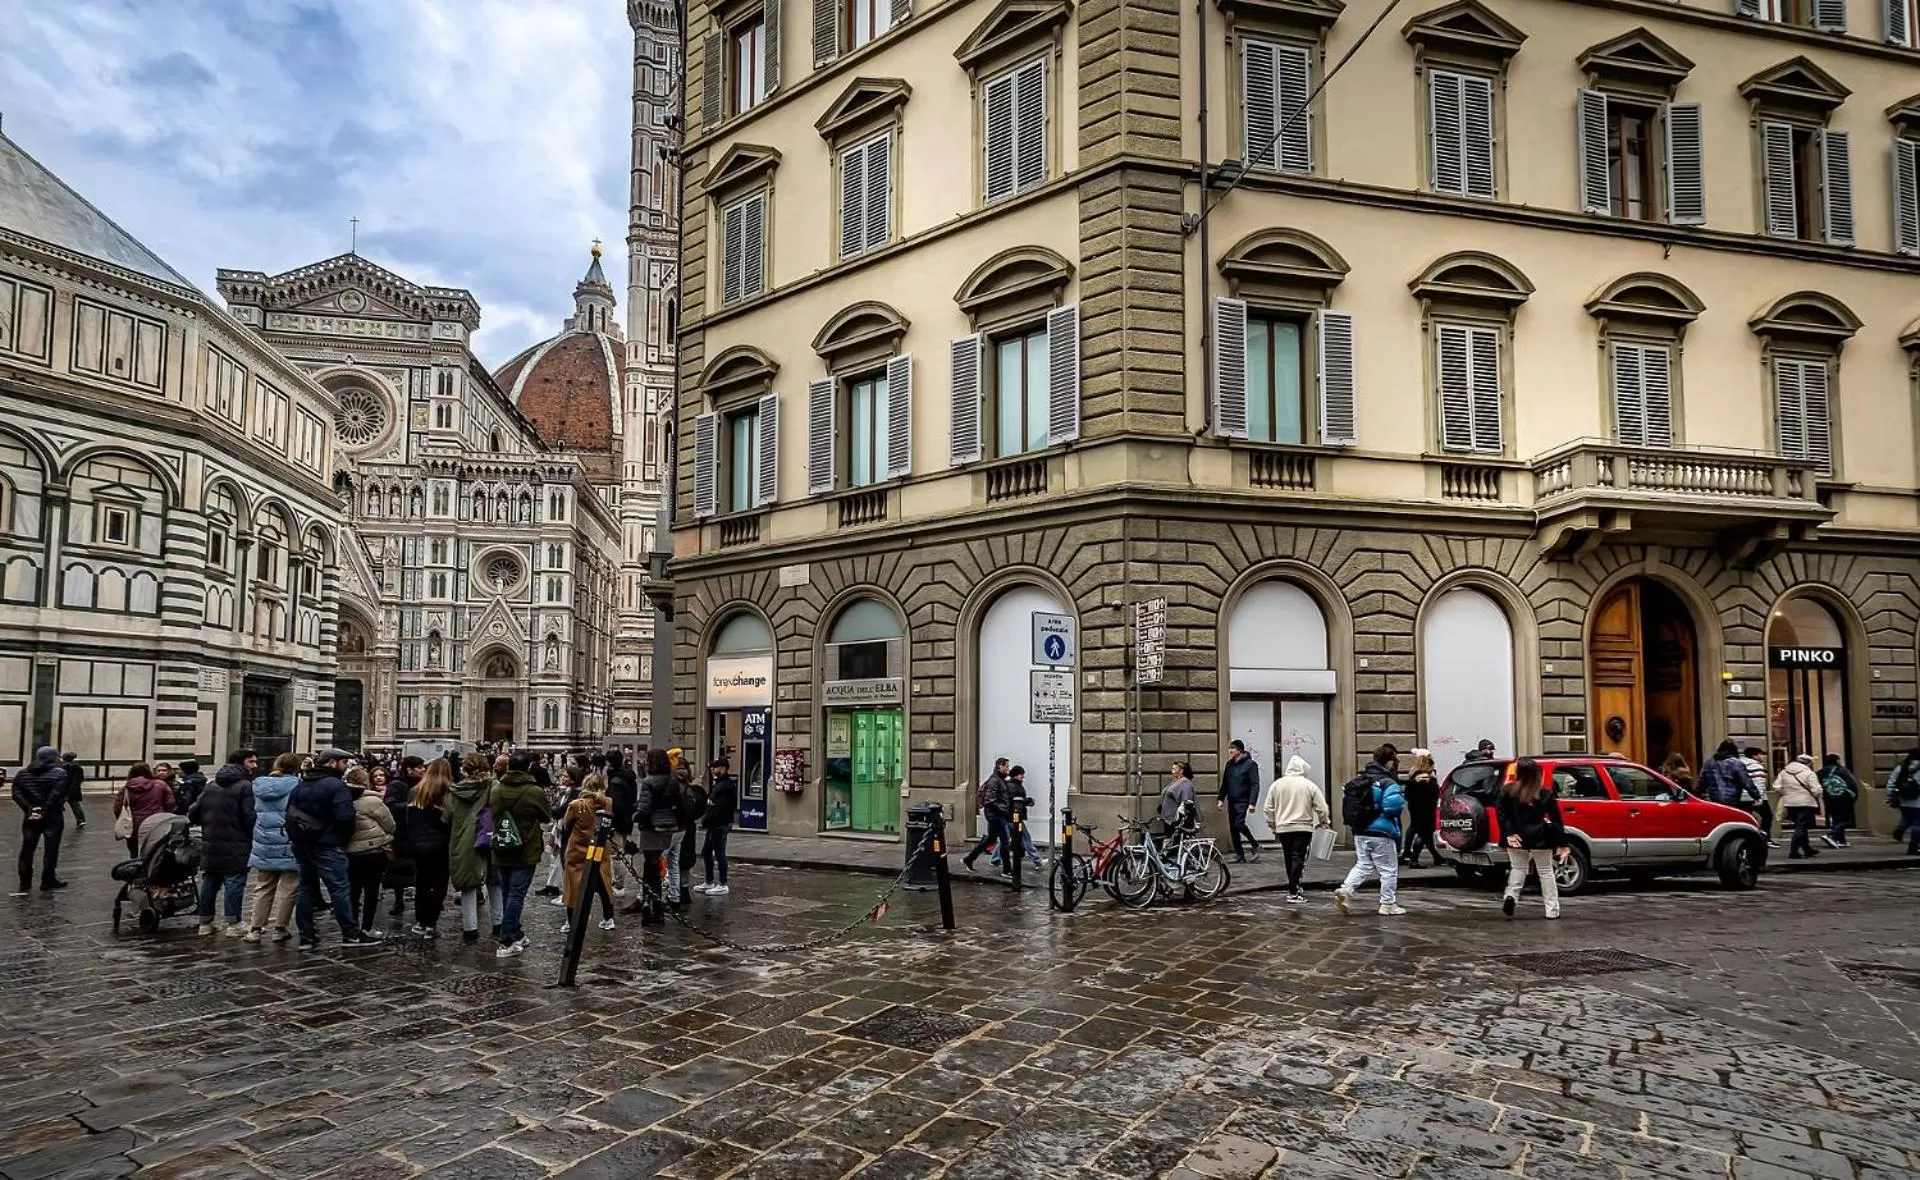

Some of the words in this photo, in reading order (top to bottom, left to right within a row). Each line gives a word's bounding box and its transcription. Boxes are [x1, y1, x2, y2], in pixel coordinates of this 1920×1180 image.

[1780, 649, 1834, 663] PINKO
[826, 685, 855, 696] ACQUA
[875, 683, 898, 692] ELBA
[744, 713, 765, 724] ATM
[1440, 818, 1473, 828] TERIOS
